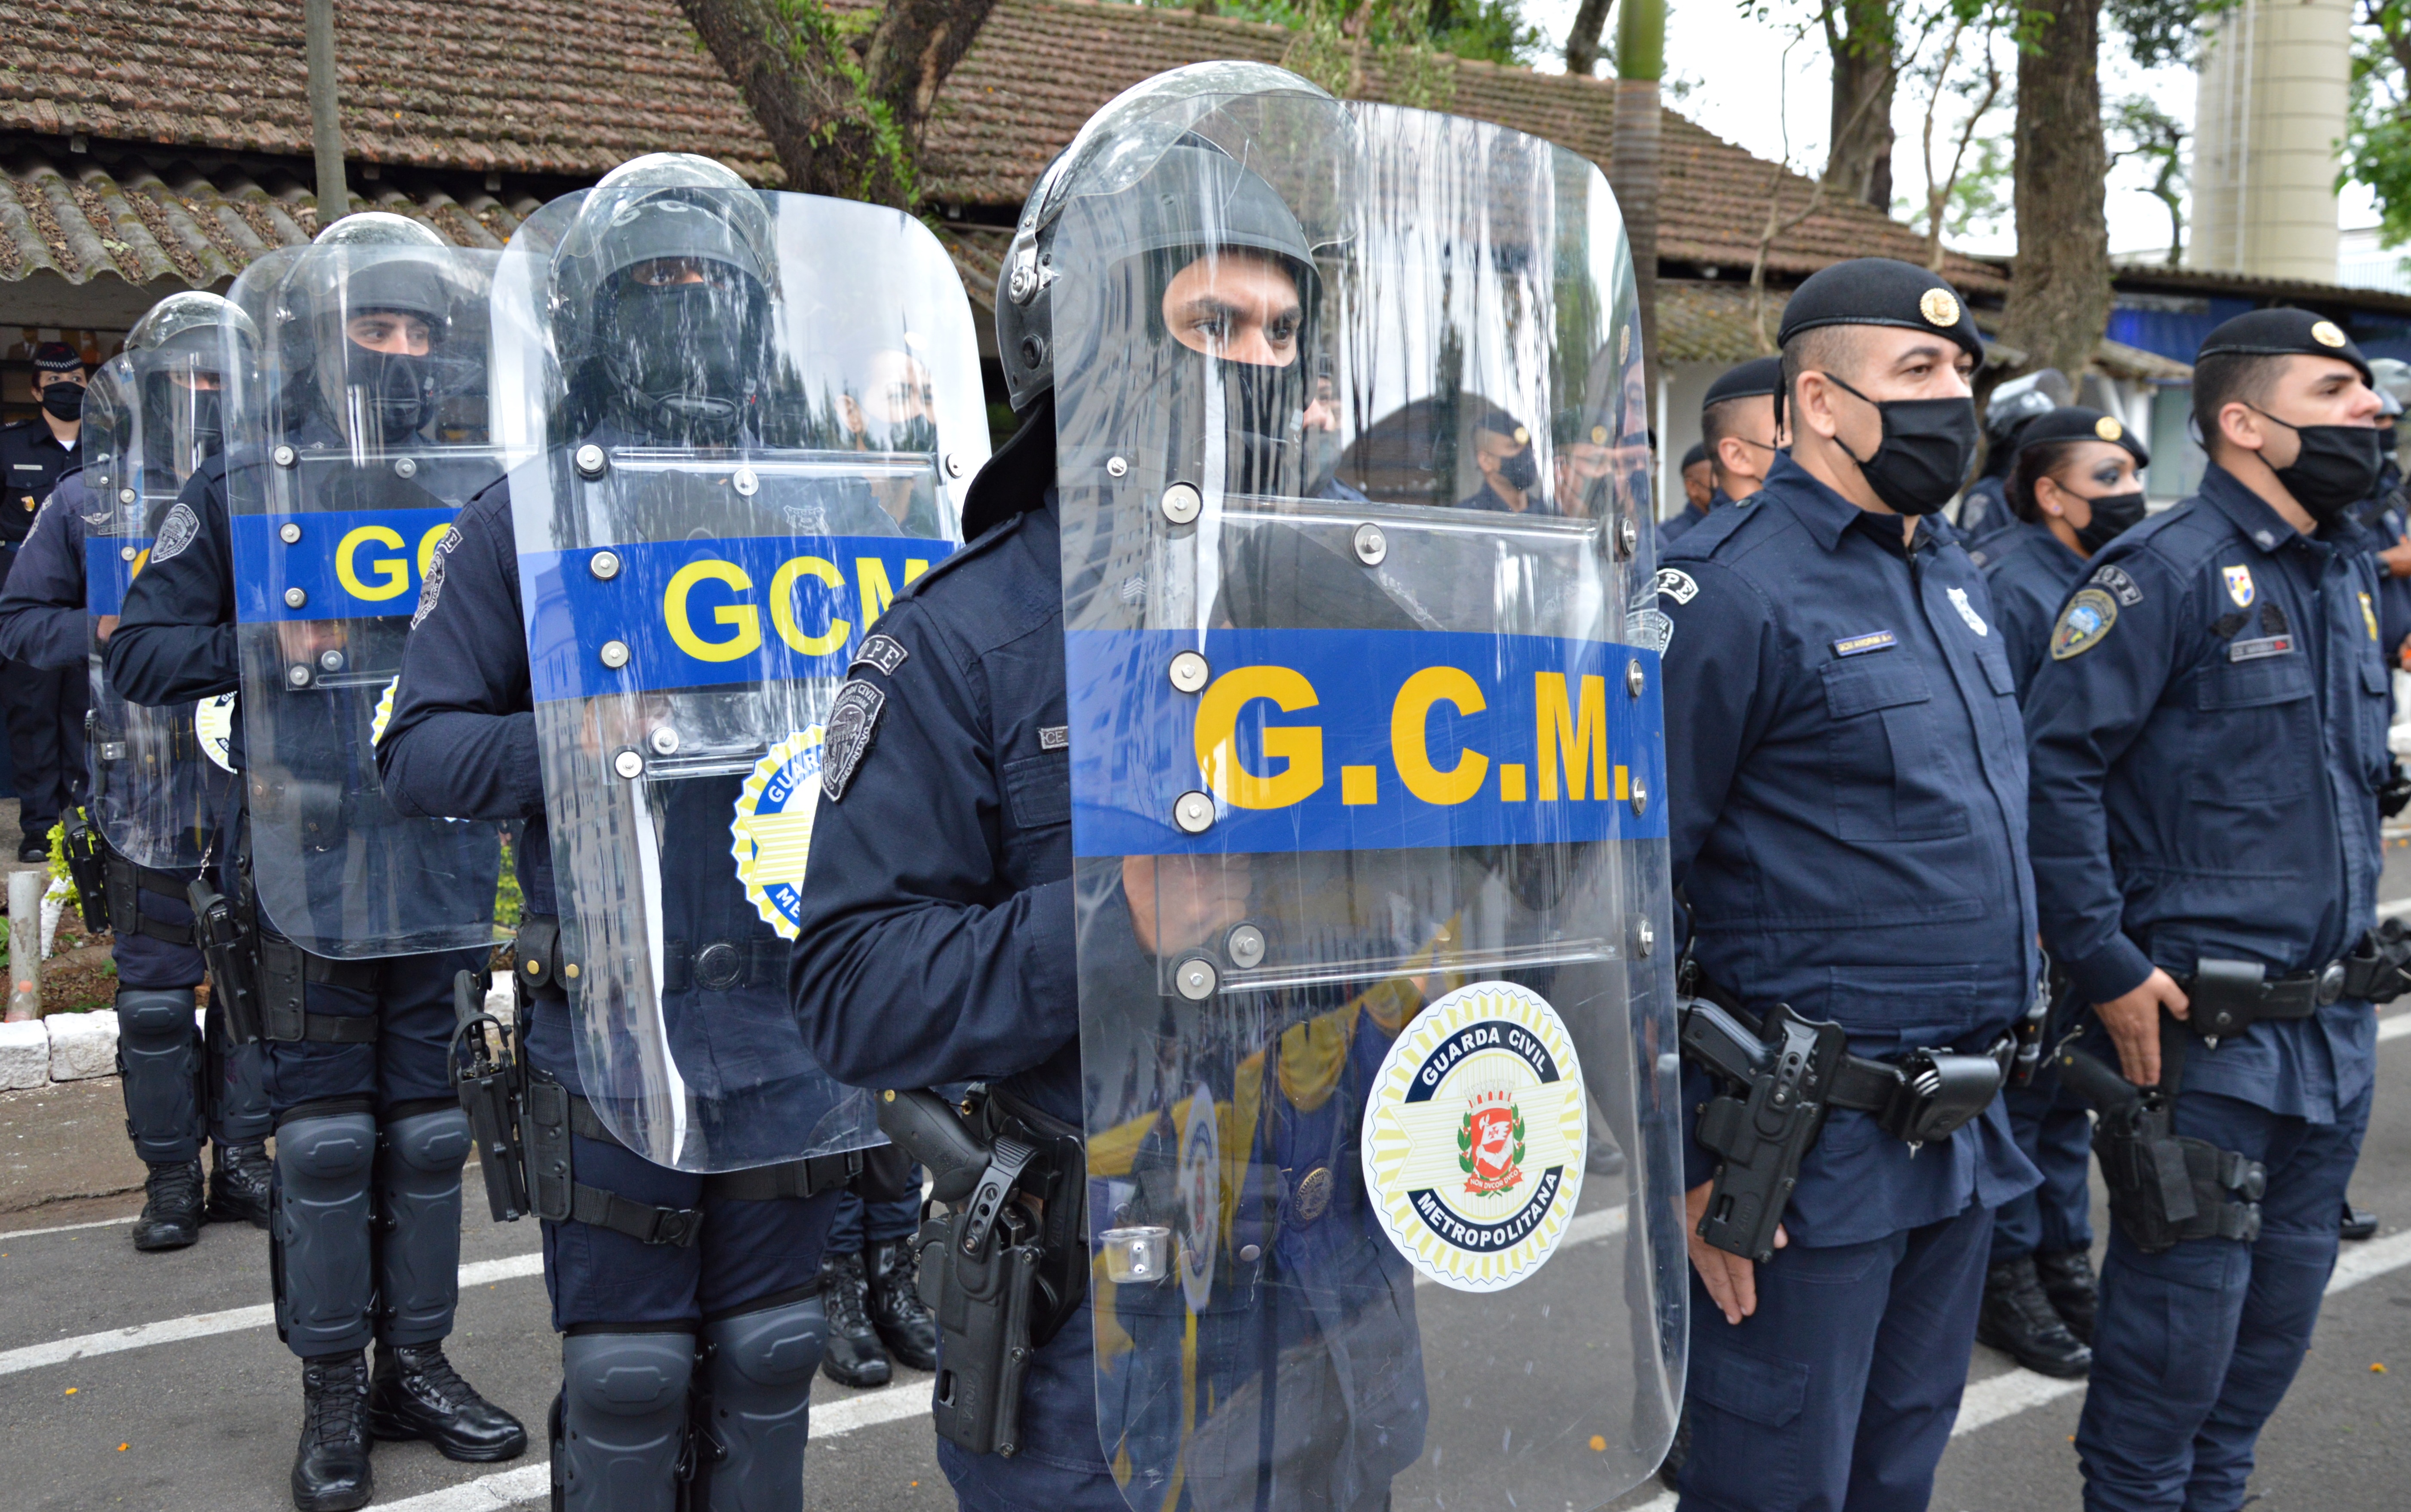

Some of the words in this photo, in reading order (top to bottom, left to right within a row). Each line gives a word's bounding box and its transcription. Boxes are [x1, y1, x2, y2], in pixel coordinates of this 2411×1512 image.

[858, 684, 878, 704] CIVIL
[839, 726, 870, 787] PREVENTIVO
[1194, 666, 1629, 809] G.C.M.
[1422, 1027, 1501, 1086] GUARDA
[1508, 1029, 1546, 1073] CIVIL
[1470, 1179, 1483, 1187] NON
[1484, 1180, 1504, 1189] DVCOR
[1504, 1170, 1519, 1183] DVCO
[1417, 1174, 1557, 1247] METROPOLITANA
